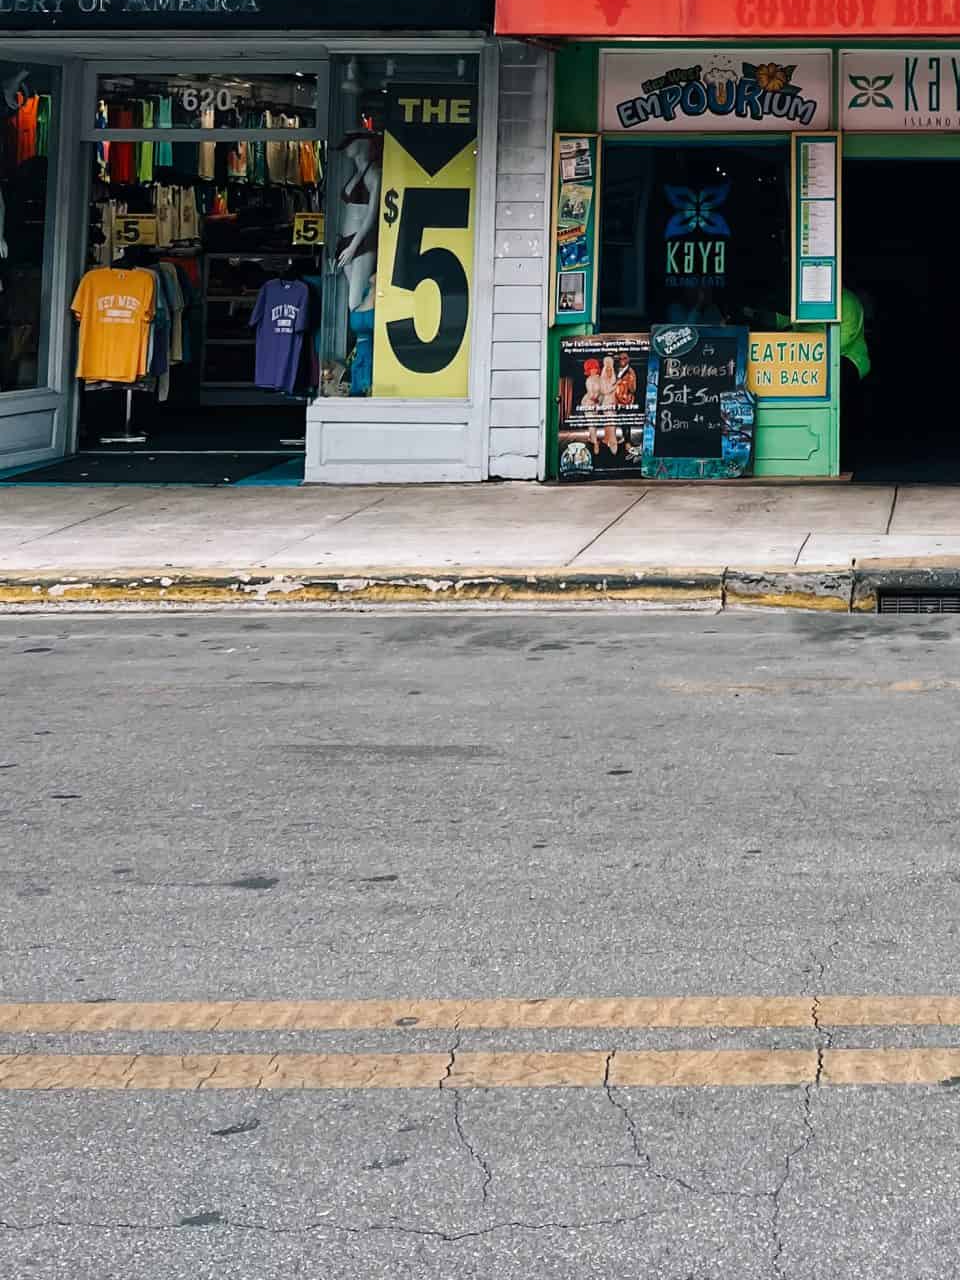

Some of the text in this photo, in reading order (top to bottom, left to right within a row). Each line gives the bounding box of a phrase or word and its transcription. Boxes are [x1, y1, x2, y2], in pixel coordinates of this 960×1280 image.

[182, 87, 233, 112] 620
[398, 98, 471, 124] THE
[617, 79, 817, 127] EMPOURIUM
[904, 117, 951, 128] ISLAND
[296, 220, 320, 243] $5
[780, 370, 818, 385] BACK
